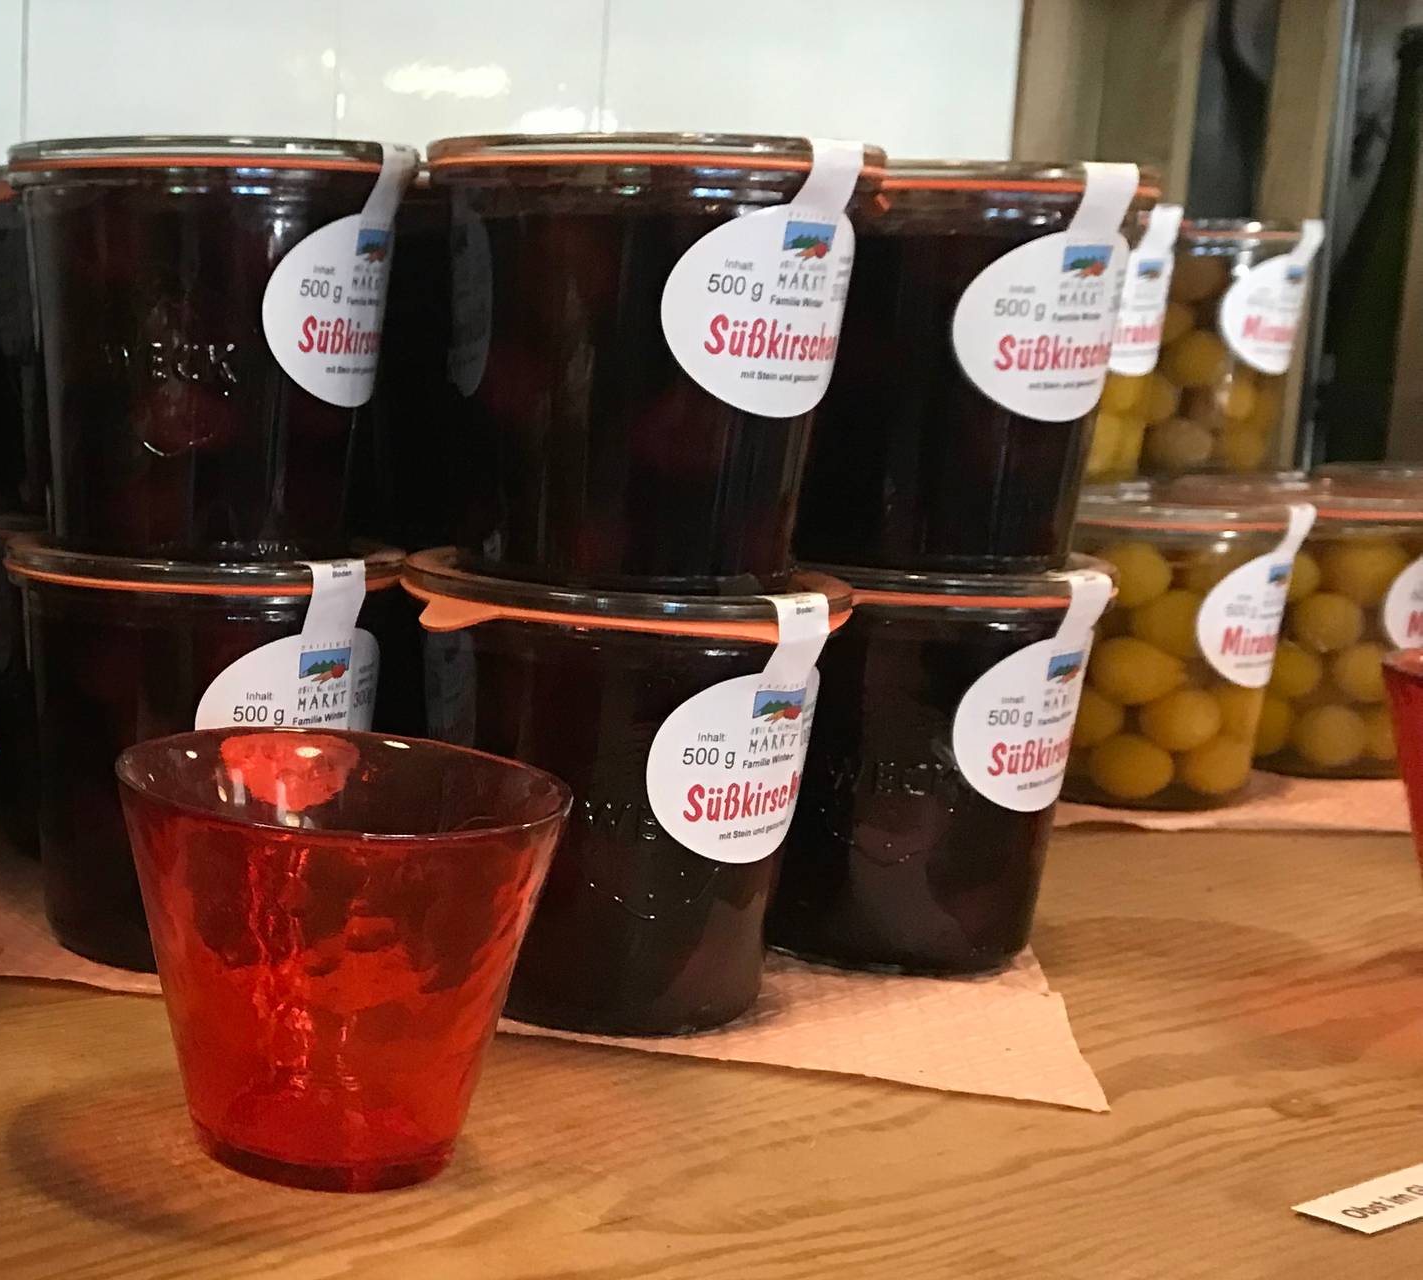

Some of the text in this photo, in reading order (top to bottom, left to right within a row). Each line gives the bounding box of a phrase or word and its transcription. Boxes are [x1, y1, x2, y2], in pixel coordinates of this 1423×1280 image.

[300, 278, 342, 303] 500 g
[707, 273, 746, 295] 500
[751, 282, 764, 302] g
[994, 298, 1046, 322] 500 g
[233, 690, 347, 725] 500 g MARKT
[988, 709, 1033, 728] 500 g
[292, 715, 322, 726] Familie
[682, 733, 798, 769] 500 g MARKT
[743, 756, 770, 768] Familie
[682, 770, 802, 823] Süßkirsch
[719, 831, 732, 840] mit
[732, 829, 752, 839] Stein
[1341, 1201, 1395, 1218] Obst
